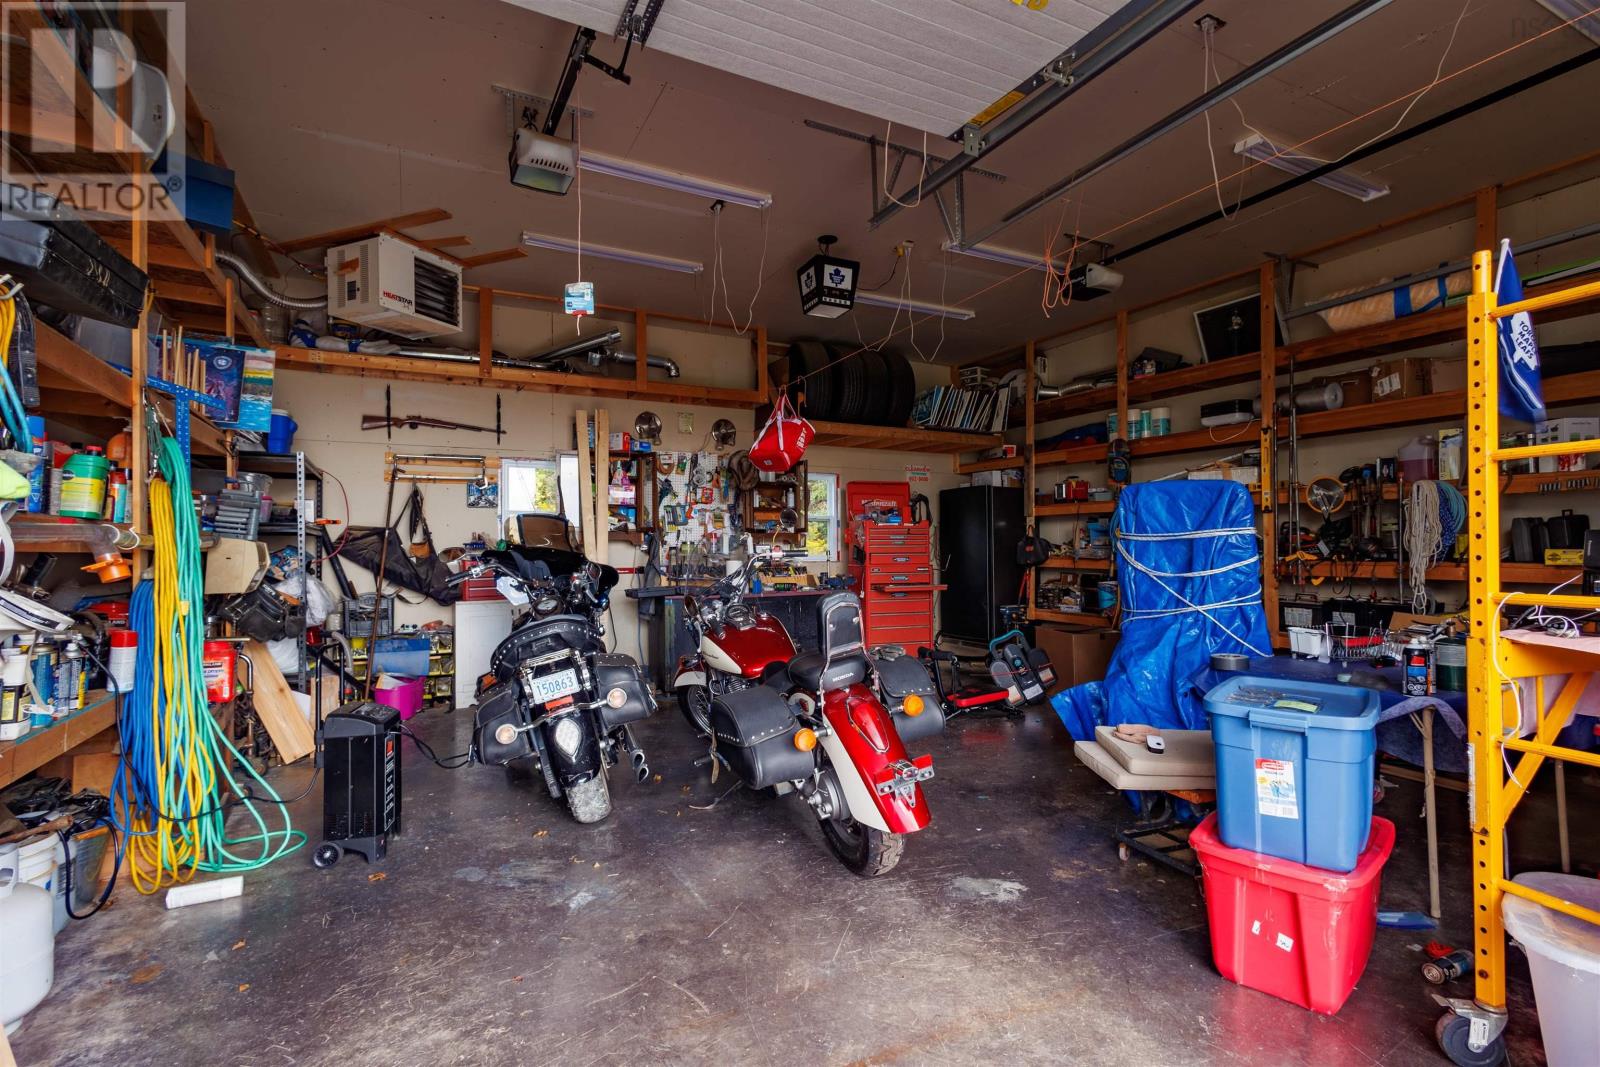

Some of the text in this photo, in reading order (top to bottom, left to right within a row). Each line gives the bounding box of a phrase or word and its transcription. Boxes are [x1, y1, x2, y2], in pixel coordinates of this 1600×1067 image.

[1515, 337, 1534, 360] LEAFS
[536, 676, 574, 697] 150863
[832, 672, 855, 683] HONDA
